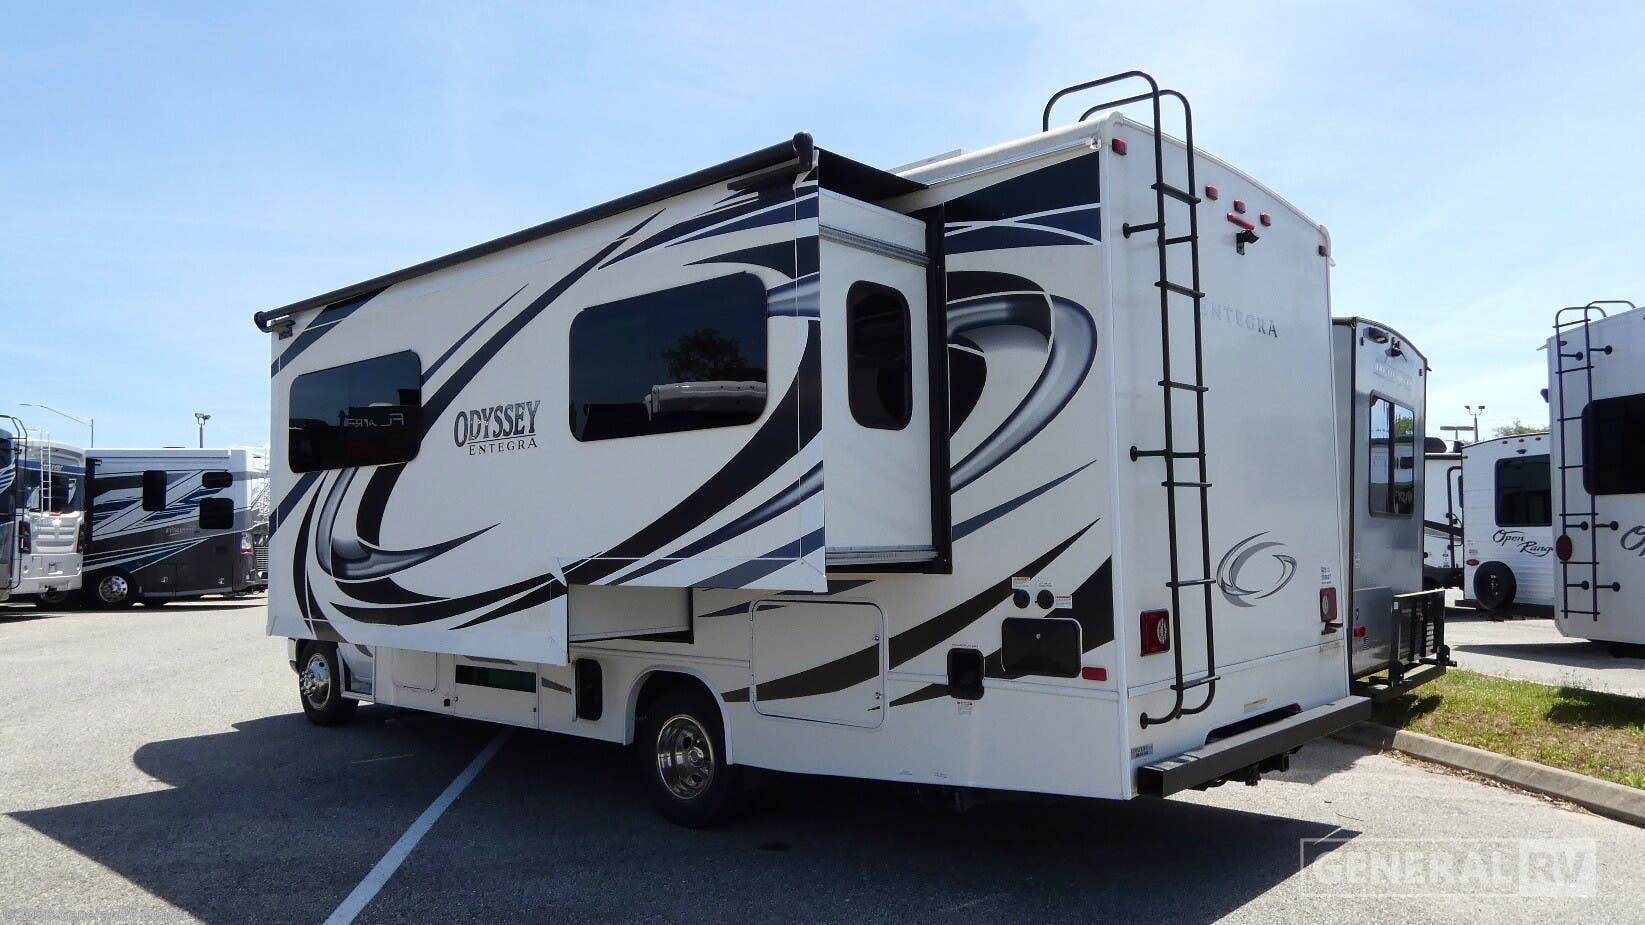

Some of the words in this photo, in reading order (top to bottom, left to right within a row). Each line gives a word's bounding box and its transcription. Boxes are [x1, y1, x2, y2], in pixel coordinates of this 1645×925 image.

[454, 400, 541, 448] ODYSSEY
[468, 437, 538, 456] ENTEGRA
[1492, 529, 1526, 546] Open
[1517, 541, 1554, 557] Rang
